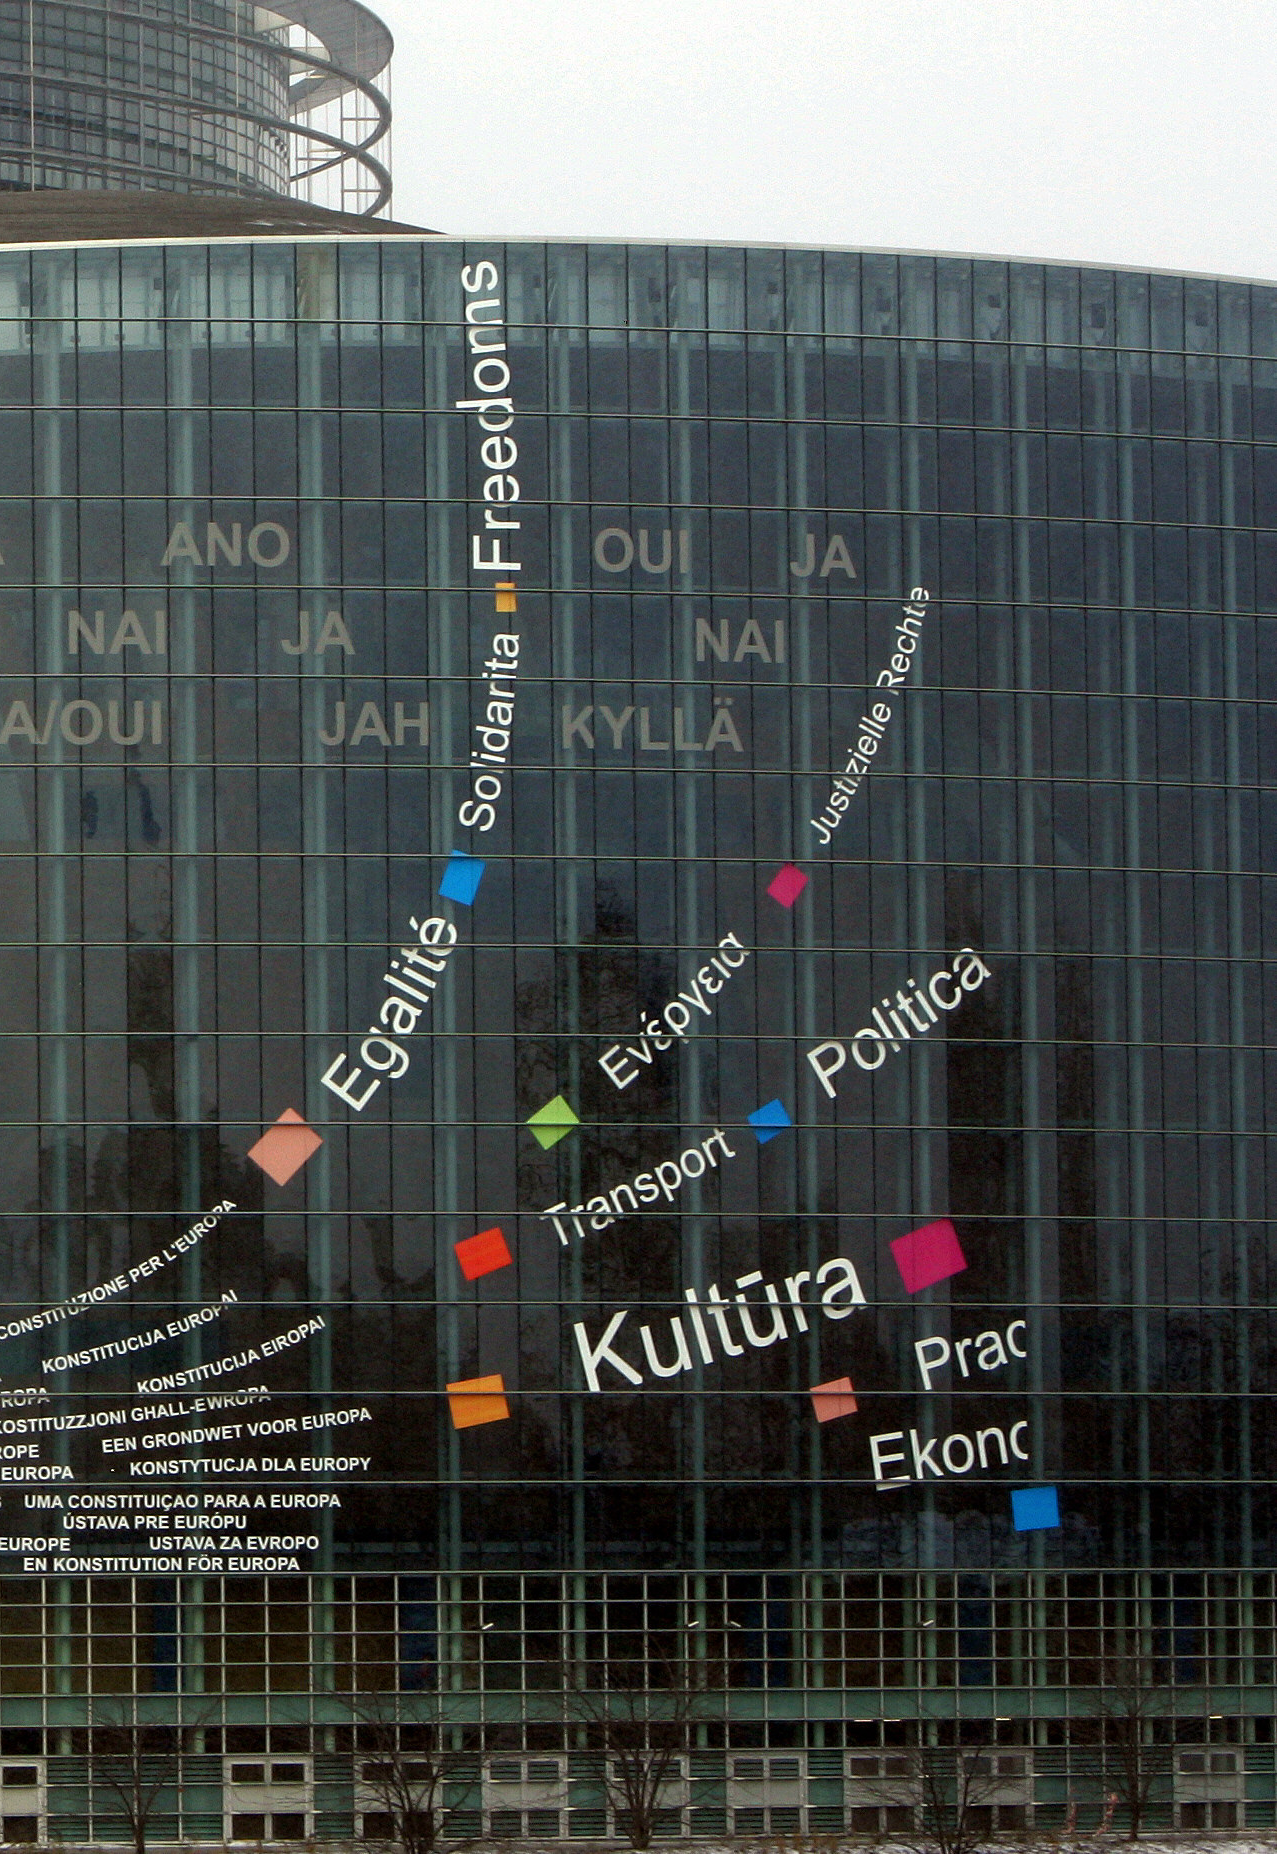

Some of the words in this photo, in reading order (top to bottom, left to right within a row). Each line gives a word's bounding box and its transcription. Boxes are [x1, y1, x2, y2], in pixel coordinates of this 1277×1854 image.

[456, 259, 522, 572] Freedoms
[160, 521, 290, 568] ANO
[594, 528, 690, 574] OUI
[790, 533, 857, 578] JA
[67, 609, 166, 655] NAI
[281, 610, 355, 656] JA
[695, 618, 785, 663] NAI
[320, 701, 430, 746] JAH
[459, 633, 520, 832] Solidarita
[561, 697, 744, 752] KYLLÄ
[810, 702, 891, 845] Justizielle
[876, 587, 930, 696] Rechte
[320, 915, 458, 1112] Egalité
[598, 932, 751, 1089] Ενέργεια
[806, 948, 992, 1098] Politica
[539, 1126, 736, 1246] Transport
[128, 1255, 165, 1284] PER
[162, 1198, 237, 1262] L'EUROPA
[42, 1329, 166, 1374] KONSTITUCIJA
[166, 1289, 239, 1338] EUROPAI
[573, 1257, 867, 1392] Kultūra
[136, 1349, 261, 1396] KONSTITUCIJA
[260, 1315, 326, 1358] EIROPAI
[130, 1385, 271, 1422] GHALL-EWROPA
[102, 1437, 137, 1454] EEN
[141, 1424, 243, 1449] GRONDWET
[246, 1418, 298, 1437] VOOR
[302, 1406, 372, 1431] EUROPA
[1, 1465, 74, 1482] EUROPA
[129, 1457, 258, 1476] KONSTYTUCJA
[261, 1457, 296, 1472] DLA
[300, 1457, 372, 1472] EUROPY
[24, 1494, 64, 1509] UMA
[203, 1494, 250, 1508] PARA
[253, 1494, 267, 1508] A
[270, 1494, 342, 1508] EUROPA
[63, 1512, 130, 1530] ÚSTAVA
[134, 1515, 169, 1529] PRE
[174, 1512, 247, 1529] EURÓPU
[23, 1557, 48, 1571] EN
[53, 1557, 182, 1571] KONSTITUTION
[187, 1553, 224, 1571] FÖR
[228, 1557, 300, 1571] EUROPA
[149, 1536, 216, 1550] USTAVA
[219, 1536, 242, 1550] ZA
[246, 1535, 320, 1550] EVROPO
